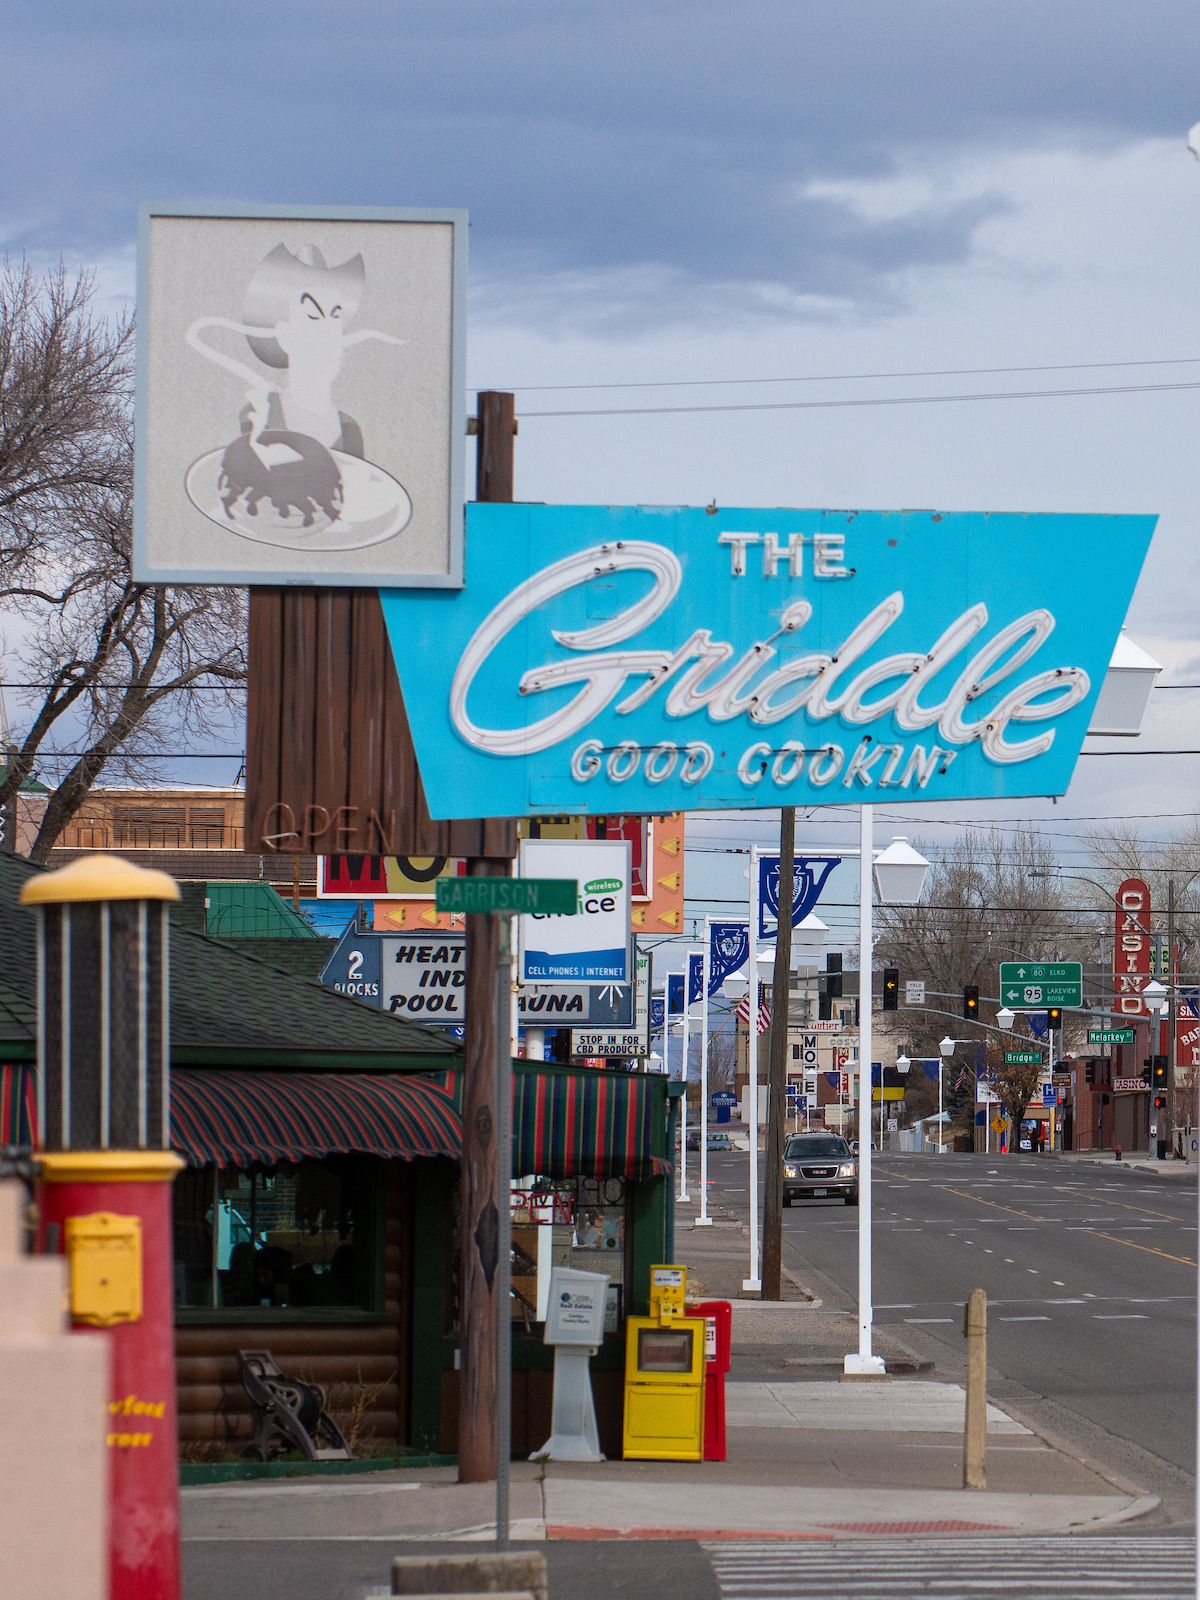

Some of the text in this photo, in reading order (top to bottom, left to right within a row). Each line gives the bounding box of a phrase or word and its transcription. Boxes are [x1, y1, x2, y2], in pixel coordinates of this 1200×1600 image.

[718, 532, 856, 577] THE
[449, 539, 1091, 764] Griddle
[571, 739, 957, 791] GOOD COOKIN'
[262, 802, 395, 853] OPEN
[587, 880, 621, 891] wireless
[438, 882, 540, 908] GARRISON
[1121, 890, 1143, 1014] CASINO
[348, 950, 364, 980] 2
[528, 967, 623, 977] CELL PHONES INTERNET
[389, 994, 458, 1012] POOL
[517, 994, 584, 1012] AUNA
[1025, 989, 1042, 999] 95
[580, 1035, 639, 1045] STOP IN FOR
[1090, 1032, 1125, 1043] Melarkey
[576, 1045, 646, 1055] CBD PRODUCTS
[1007, 1054, 1033, 1062] Bridge
[1045, 1085, 1054, 1095] H
[510, 1192, 573, 1224] PEN
